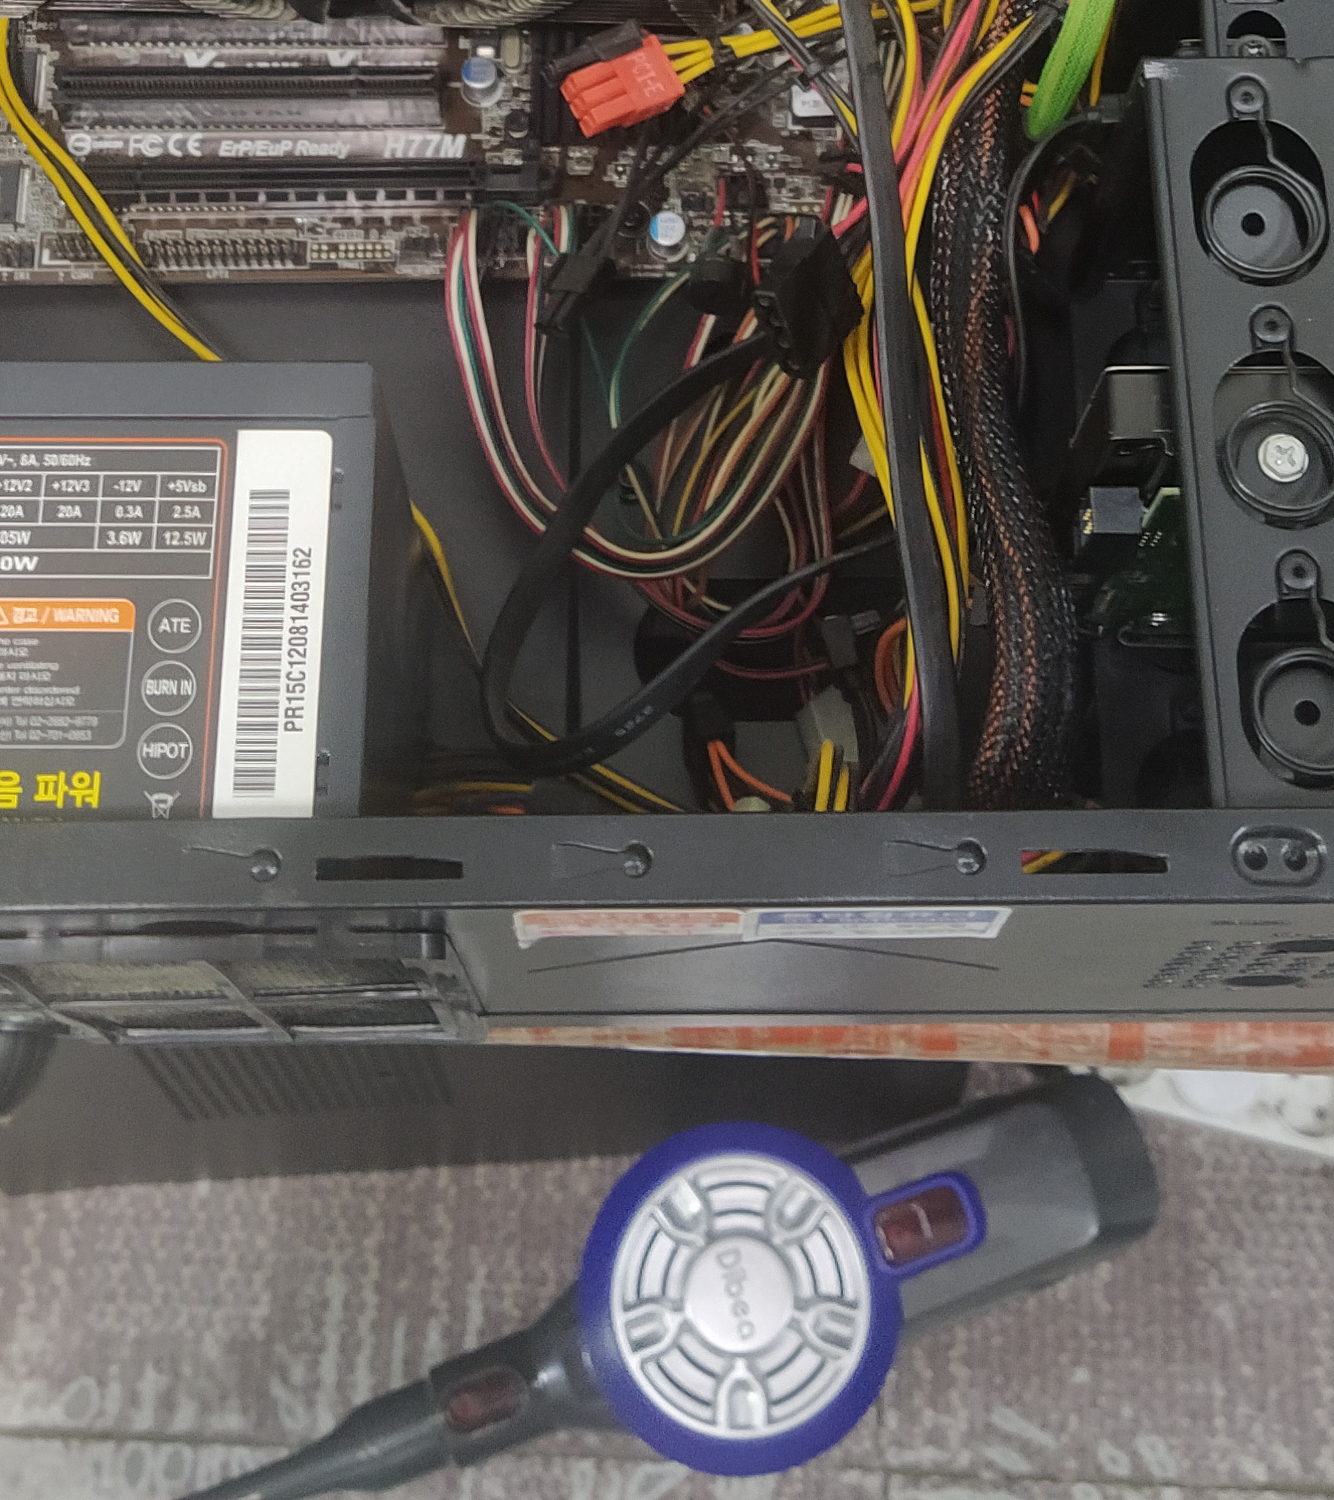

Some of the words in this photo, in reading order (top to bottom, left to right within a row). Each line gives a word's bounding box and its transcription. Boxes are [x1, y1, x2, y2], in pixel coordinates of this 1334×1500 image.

[218, 138, 293, 159] ErP/EuP
[296, 139, 351, 160] Ready
[383, 133, 467, 160] H77M
[51, 479, 91, 493] +12V3
[113, 479, 143, 493] -12V
[167, 479, 207, 494] +5Vsb
[56, 504, 82, 518] 20A
[114, 505, 143, 519] 0.3A
[172, 505, 202, 519] 2.5A
[106, 530, 143, 546] 3.6W
[163, 531, 208, 547] 12.5W
[53, 607, 120, 623] WARNING
[158, 617, 192, 634] ATE
[283, 546, 313, 733] PR15C12081403162
[145, 679, 177, 696] BURN
[178, 679, 193, 696] IN
[142, 742, 189, 759] HIPOT
[33, 770, 101, 809] 파워
